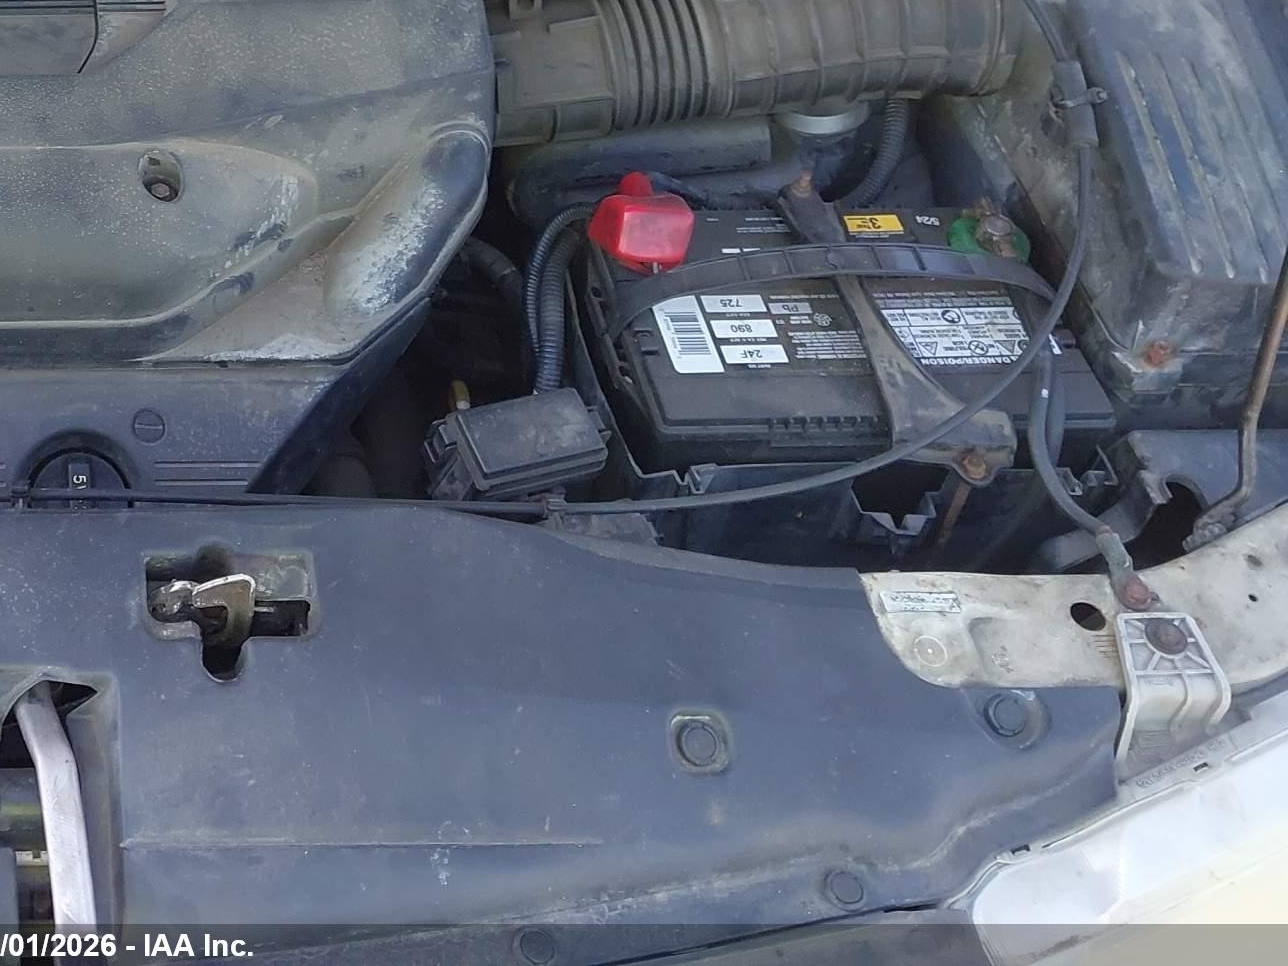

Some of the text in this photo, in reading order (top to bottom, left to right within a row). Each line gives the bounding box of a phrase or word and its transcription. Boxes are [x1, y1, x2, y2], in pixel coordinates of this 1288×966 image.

[720, 298, 742, 308] 725
[782, 304, 799, 312] Pb
[730, 323, 753, 333] 890
[740, 348, 764, 358] 24F
